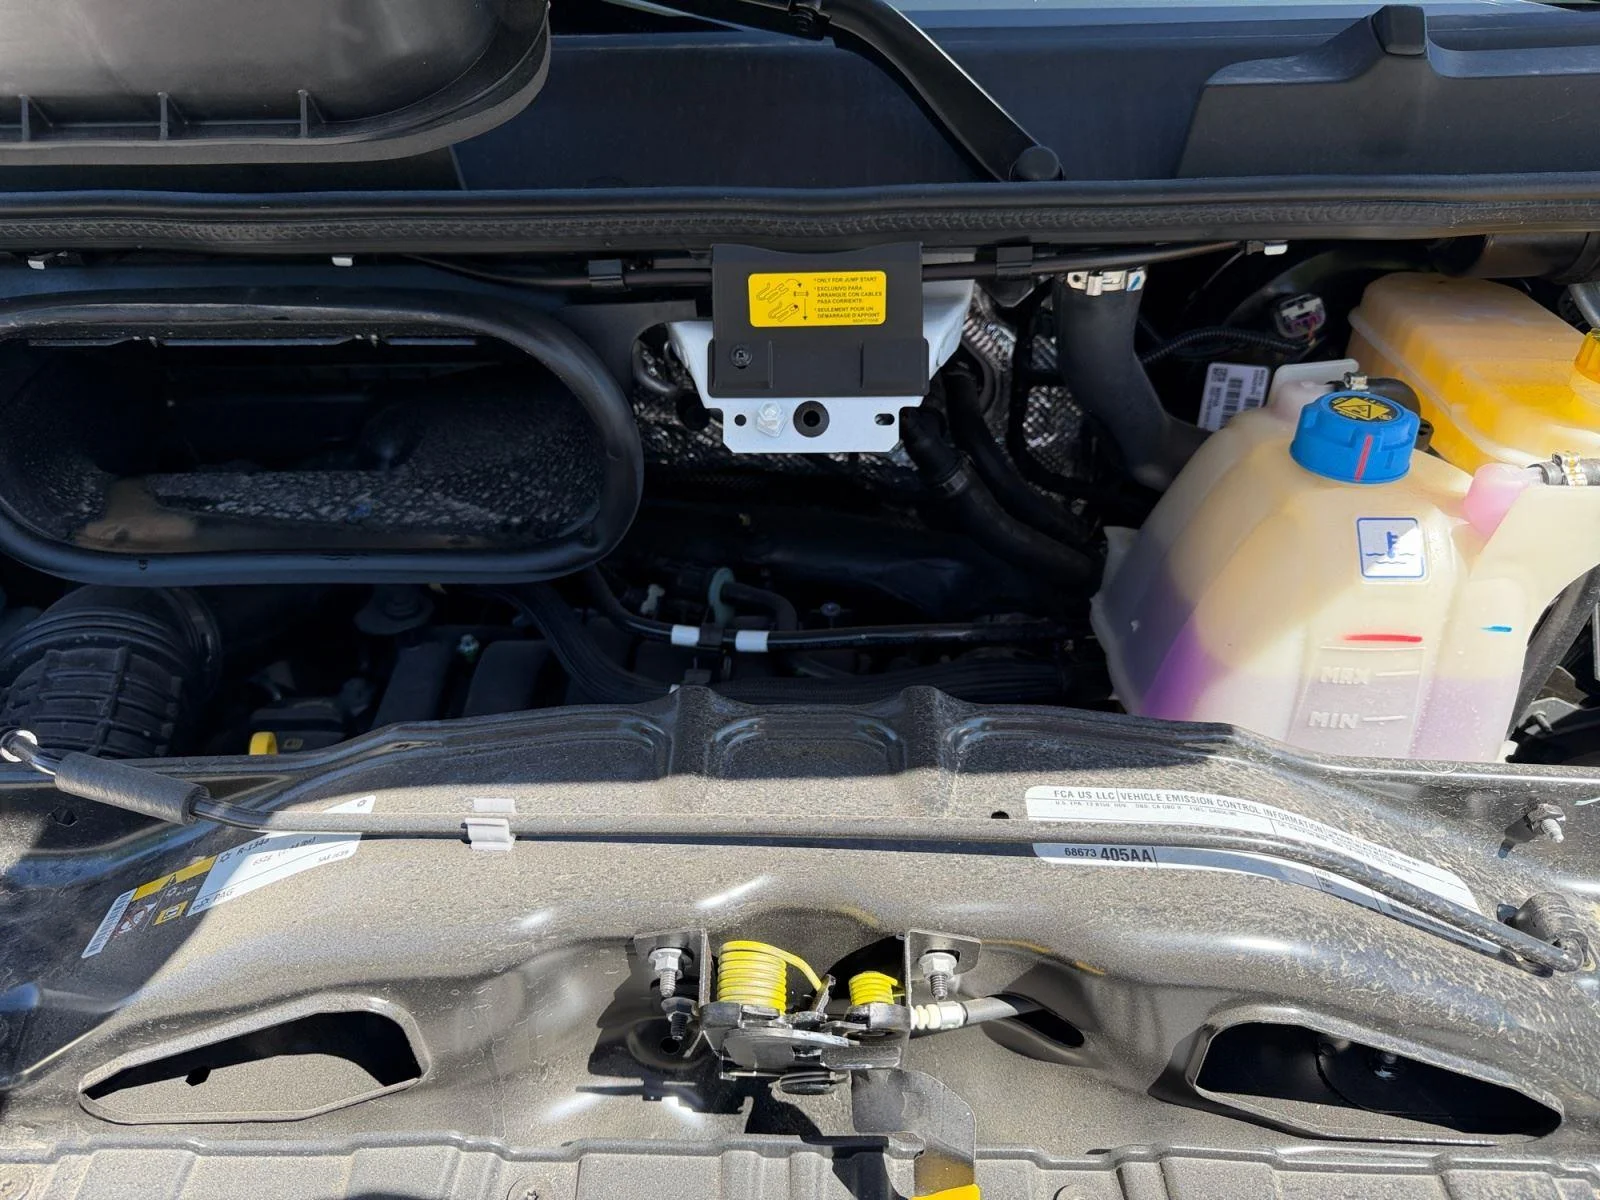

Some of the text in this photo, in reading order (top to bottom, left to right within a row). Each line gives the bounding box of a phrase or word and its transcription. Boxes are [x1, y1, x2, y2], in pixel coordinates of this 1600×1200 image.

[1308, 711, 1359, 729] MIN
[1054, 790, 1074, 798] FCA
[1077, 791, 1092, 799] US
[1120, 792, 1163, 801] VEHICLE
[1166, 793, 1213, 805] EMISSION
[1217, 799, 1260, 814] CONTROL
[1263, 808, 1324, 832] INFORMATION
[1064, 847, 1153, 863] 68673 405AA
